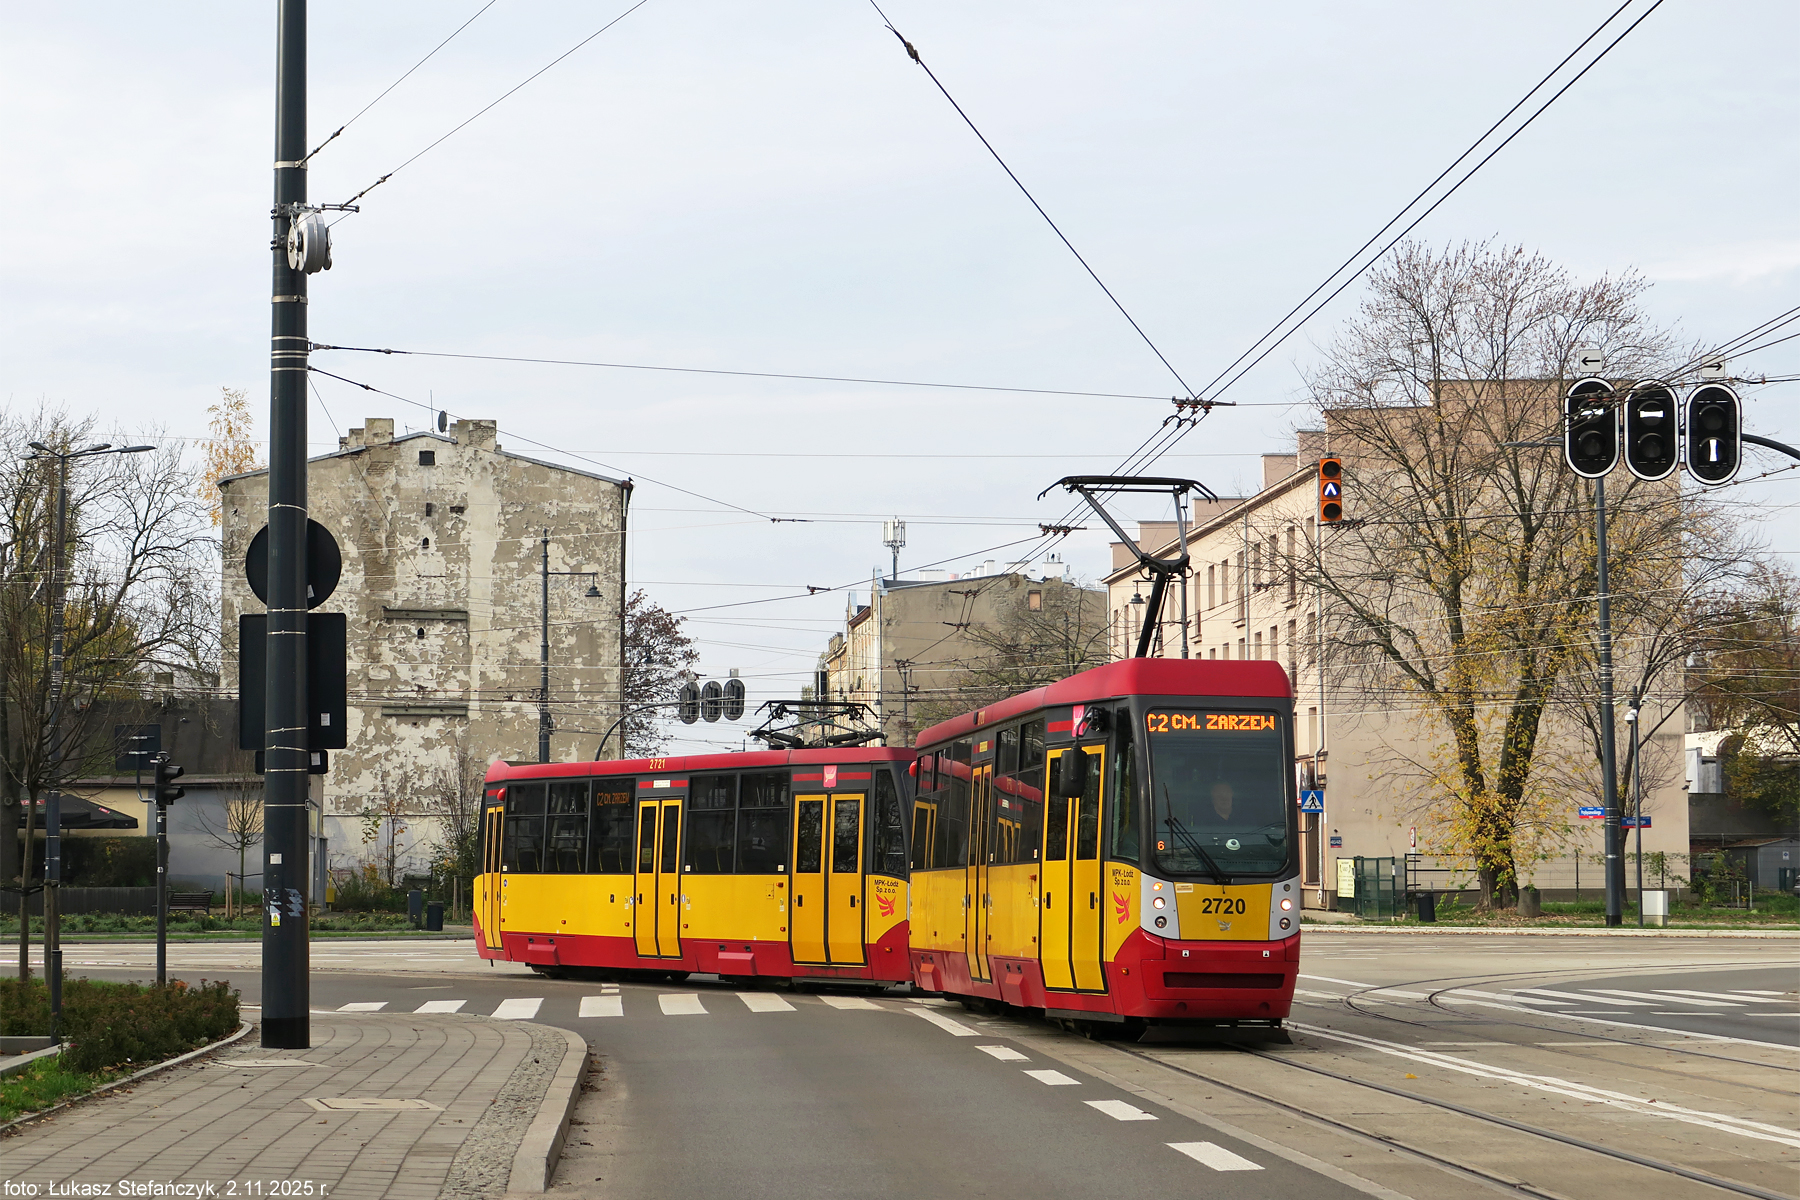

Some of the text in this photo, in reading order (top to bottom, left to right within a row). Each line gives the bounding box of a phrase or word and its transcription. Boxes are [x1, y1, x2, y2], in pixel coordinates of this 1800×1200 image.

[1147, 713, 1275, 732] C2 CM. ZARZEW
[649, 758, 666, 769] 2721
[1157, 840, 1165, 851] 6
[1202, 898, 1246, 915] 2720
